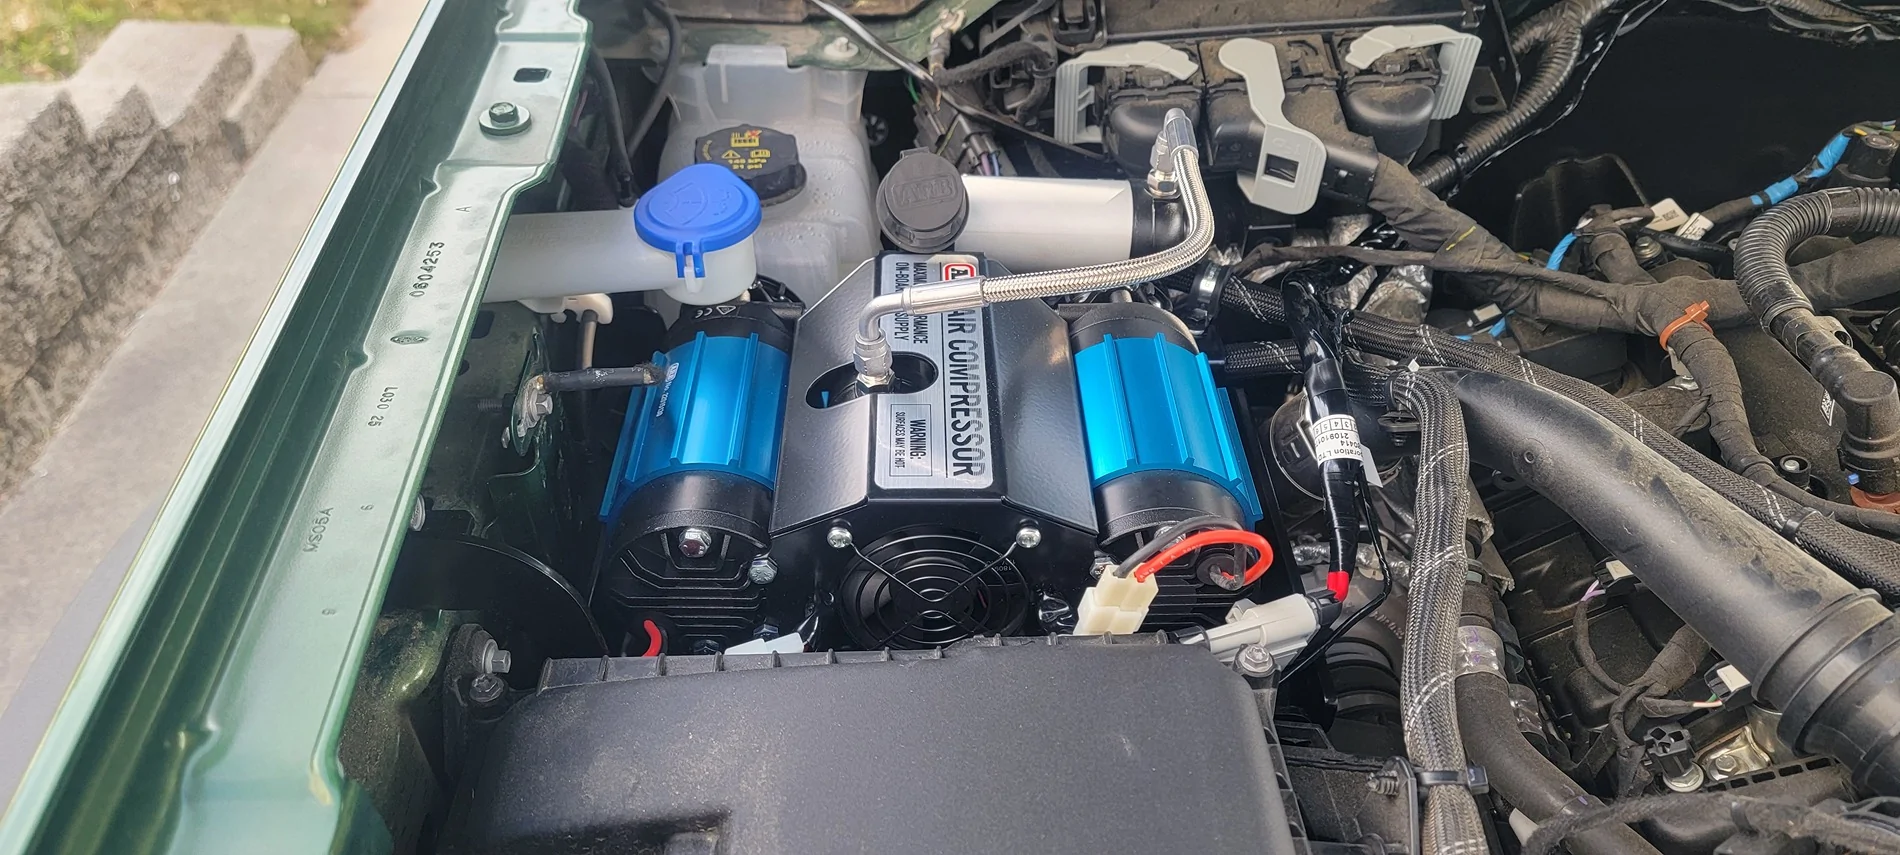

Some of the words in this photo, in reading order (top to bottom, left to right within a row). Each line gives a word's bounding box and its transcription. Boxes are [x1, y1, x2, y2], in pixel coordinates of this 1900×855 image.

[899, 178, 953, 205] ARB
[894, 312, 909, 341] SUPPLY
[947, 309, 977, 334] AIR
[948, 339, 986, 477] COMPRESSOR
[895, 412, 906, 437] SURFACES
[895, 437, 906, 449] MAY
[910, 419, 927, 460] WARNING:
[895, 449, 906, 457] BE
